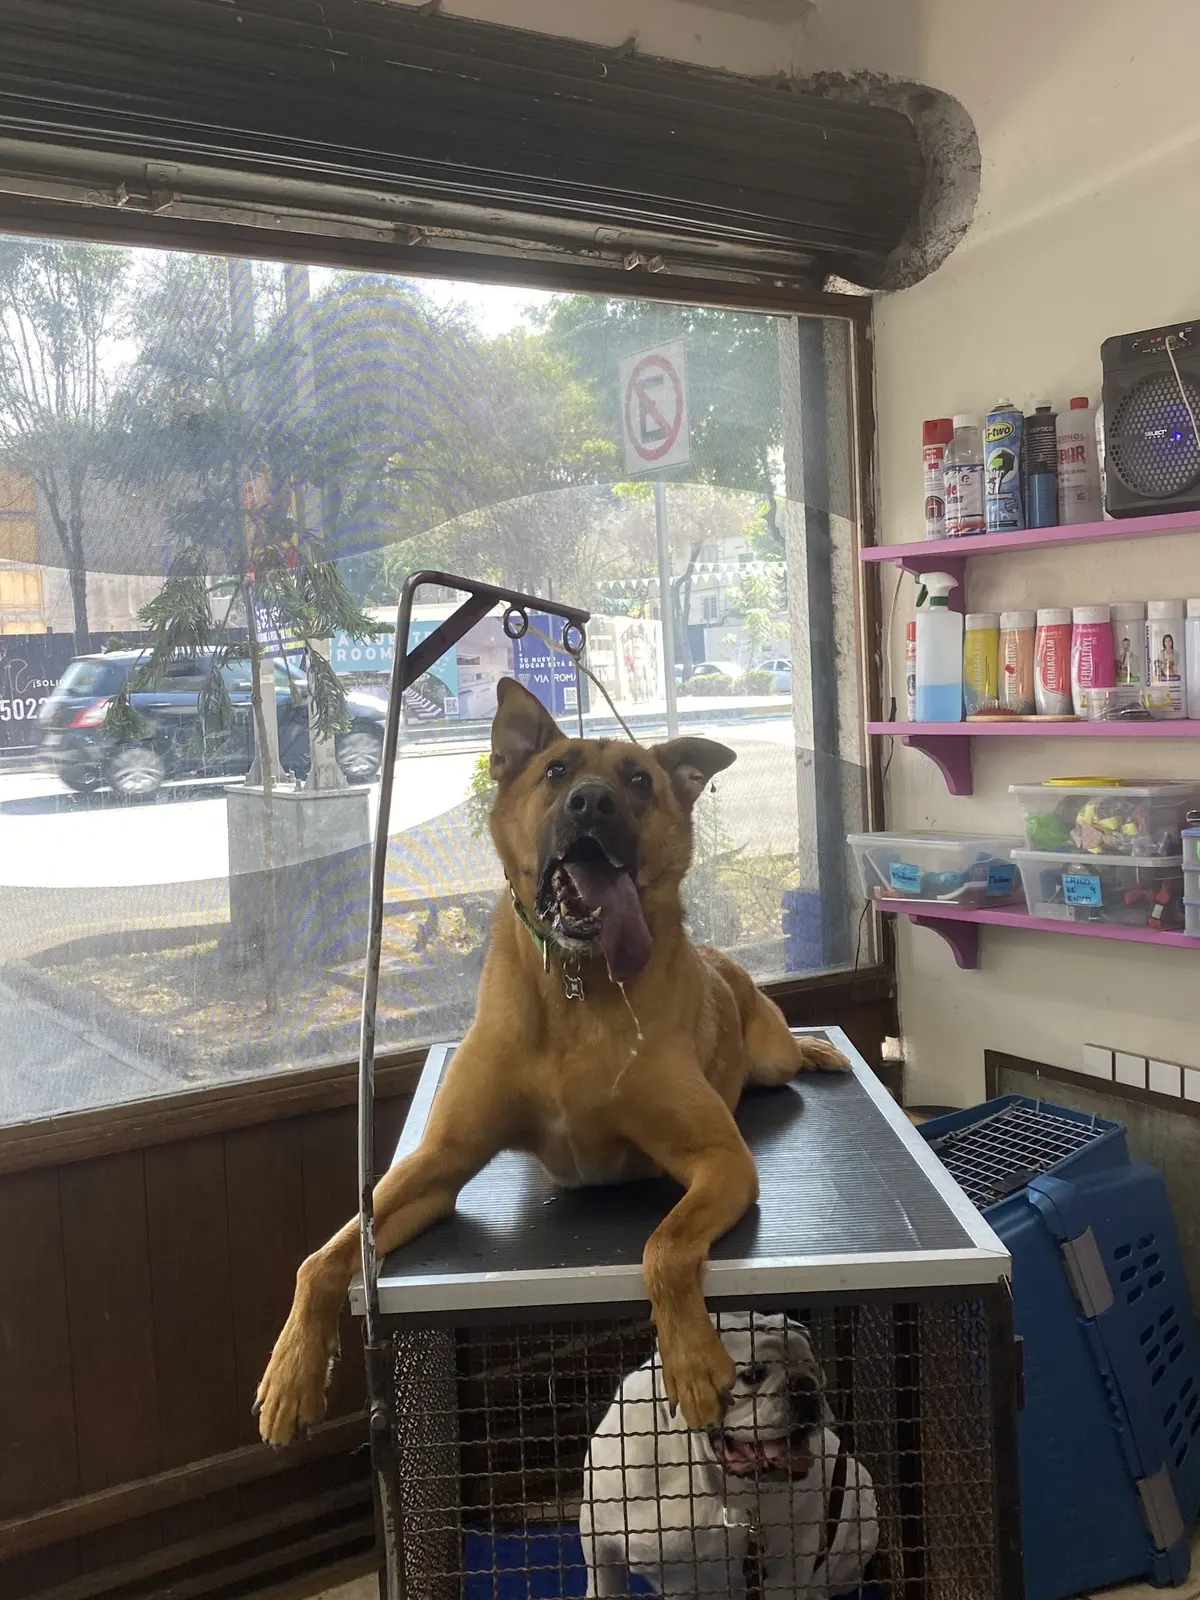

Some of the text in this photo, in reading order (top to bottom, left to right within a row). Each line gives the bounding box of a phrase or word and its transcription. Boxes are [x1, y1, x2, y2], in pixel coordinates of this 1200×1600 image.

[533, 674, 550, 683] VIA
[1007, 643, 1017, 694] BENZDERM
[1046, 639, 1056, 690] DERMACALM
